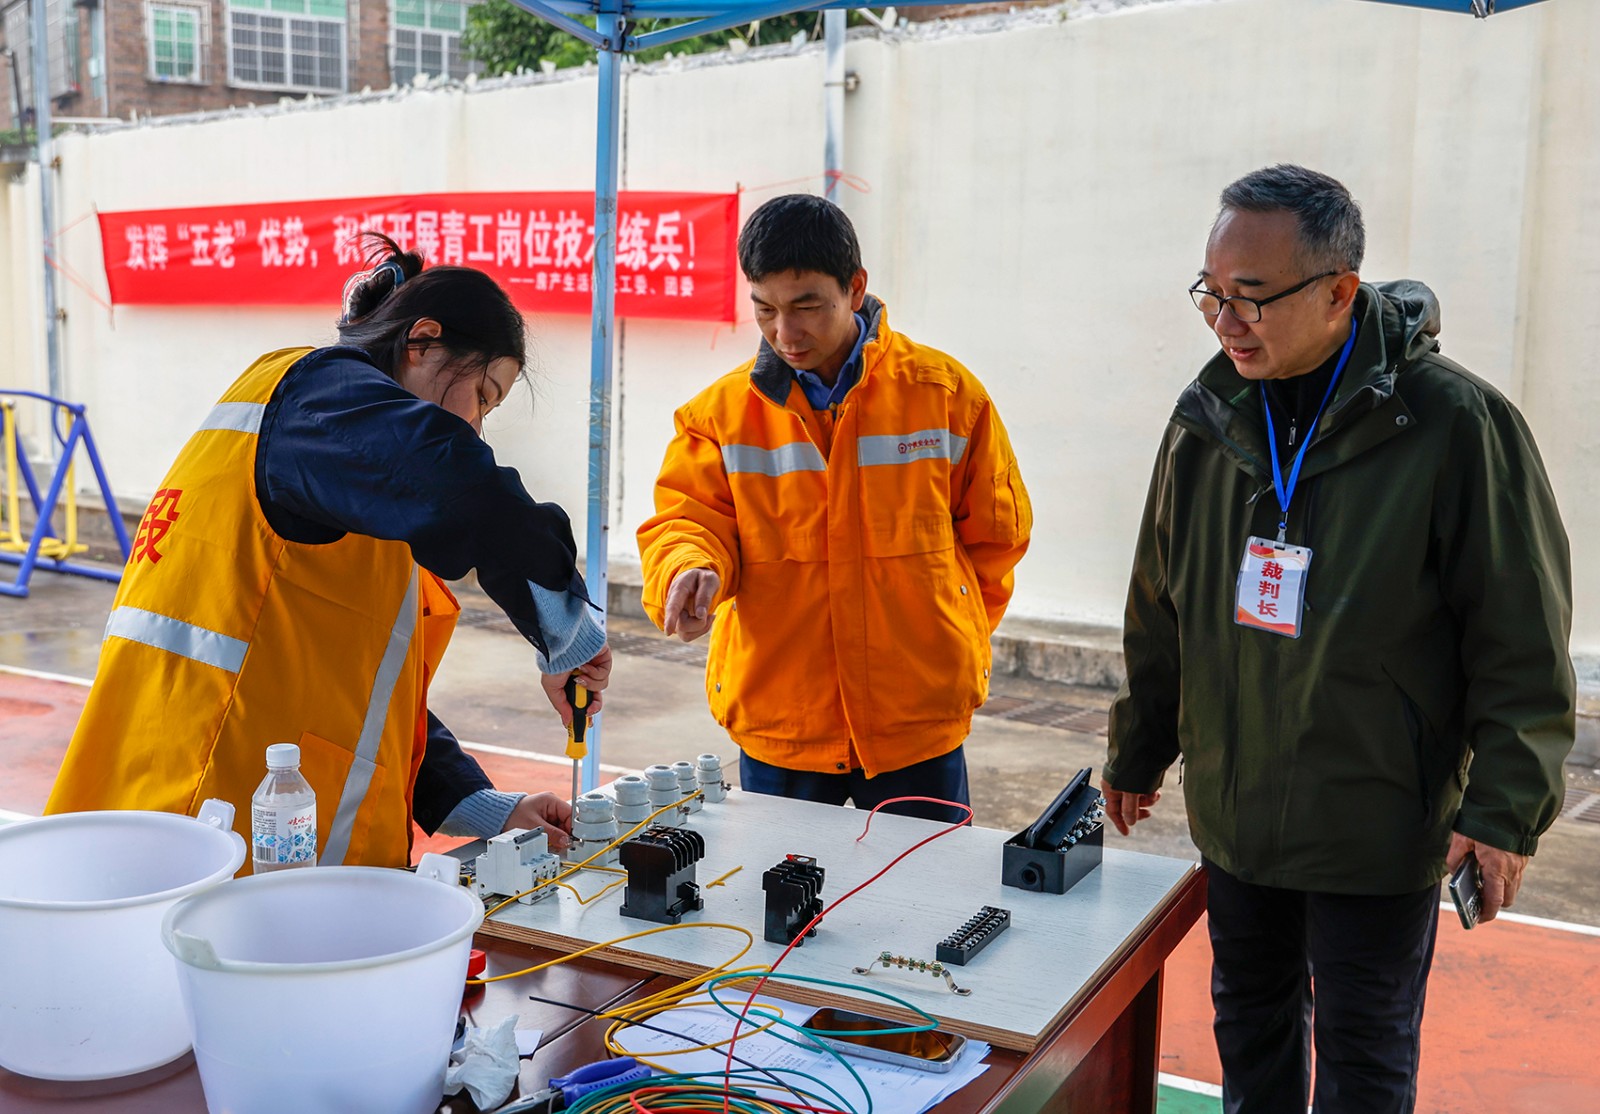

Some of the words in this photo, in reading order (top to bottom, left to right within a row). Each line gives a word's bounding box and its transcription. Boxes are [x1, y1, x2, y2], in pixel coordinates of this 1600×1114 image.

[125, 209, 695, 271] 发挥“五老”优势，积极开展青工岗位技练兵！
[509, 271, 694, 297] ——房产生活工委、团委
[1257, 560, 1284, 618] 裁判长
